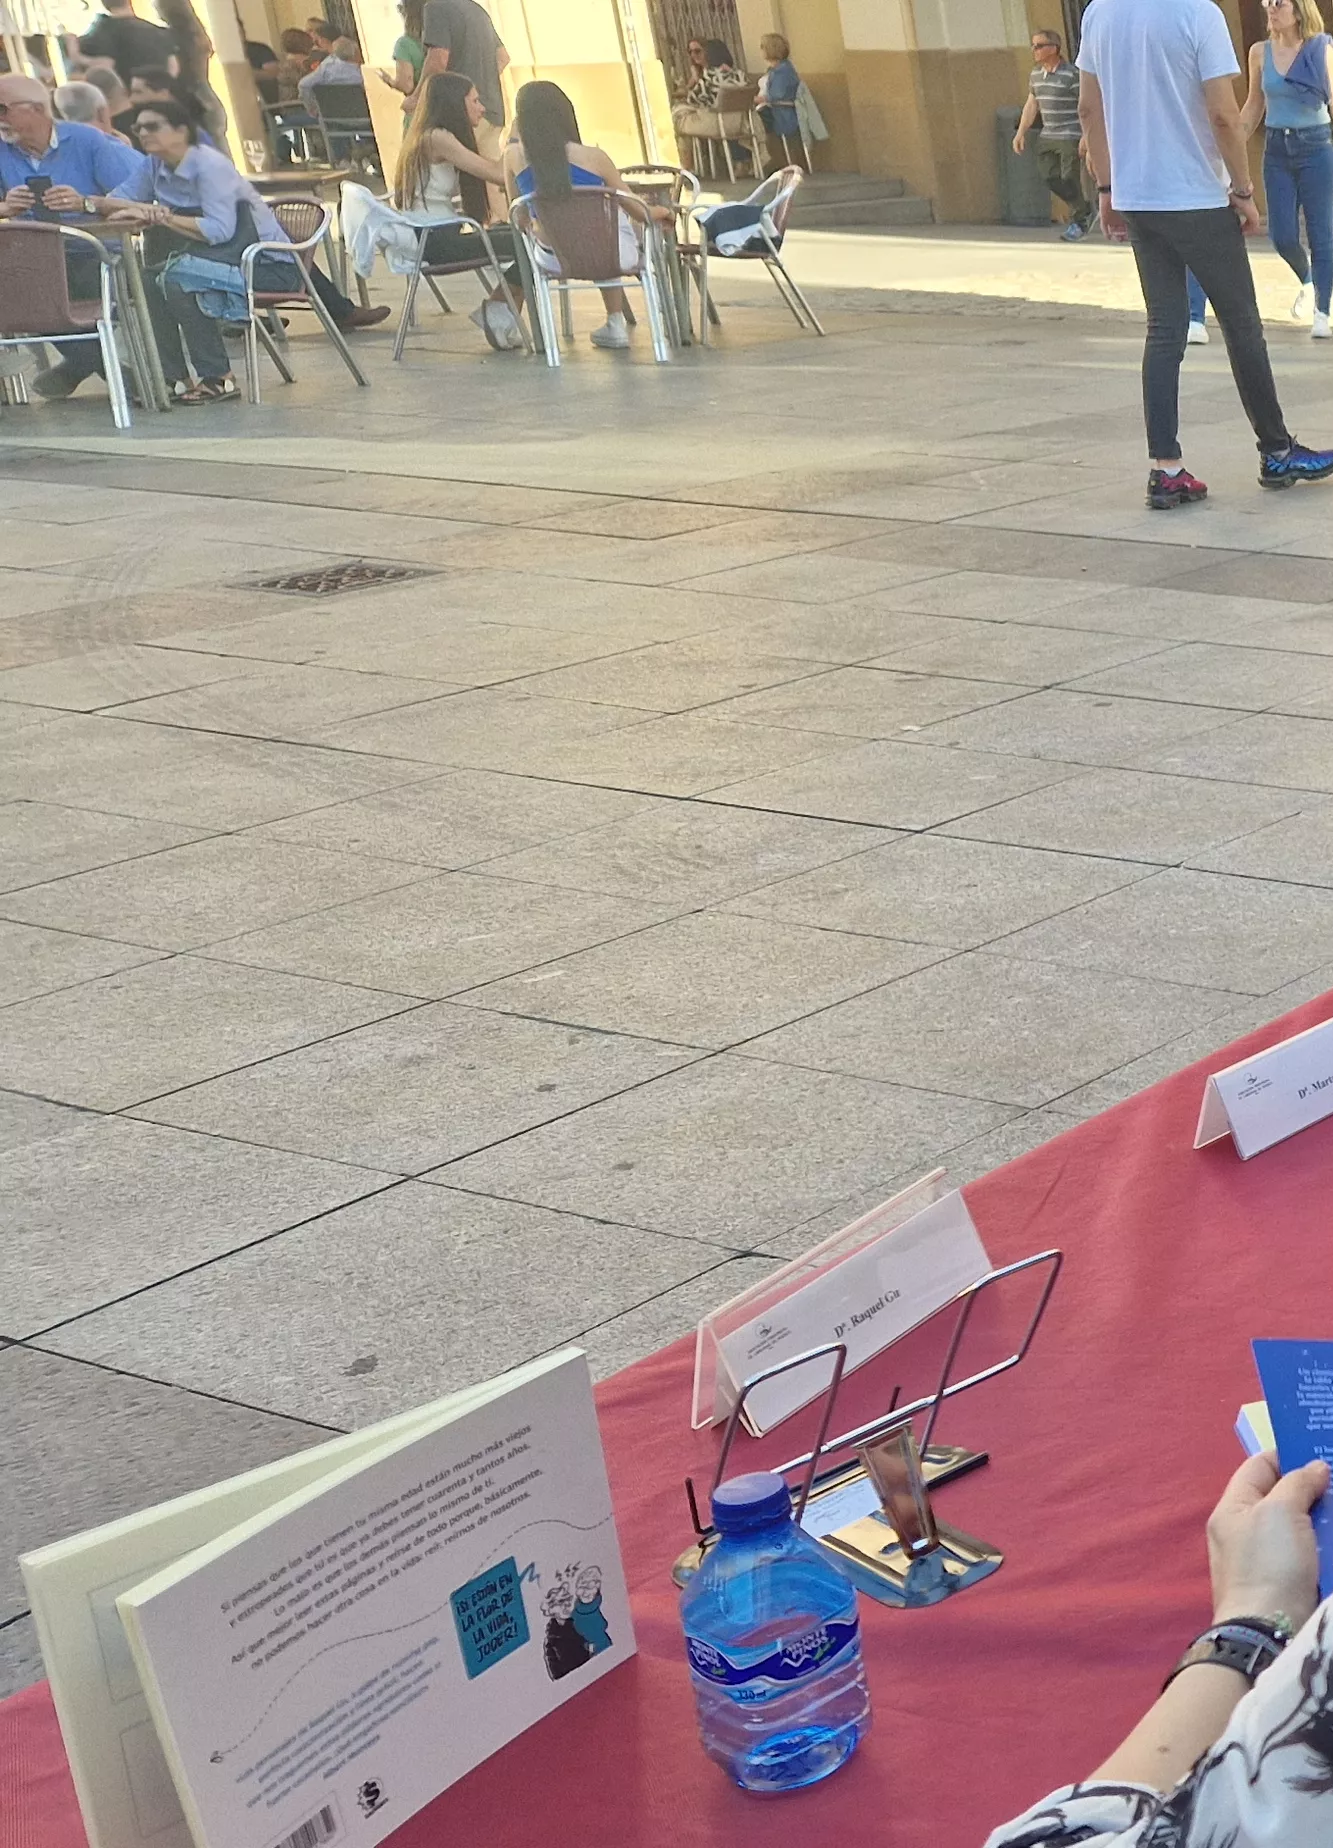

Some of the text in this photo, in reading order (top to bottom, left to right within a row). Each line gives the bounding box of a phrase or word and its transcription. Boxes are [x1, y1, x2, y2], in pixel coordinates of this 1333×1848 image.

[850, 1297, 884, 1327] Raquel
[884, 1290, 900, 1303] Gu
[248, 1638, 265, 1653] que
[413, 1535, 425, 1546] de
[427, 1522, 447, 1537] todo
[449, 1502, 483, 1527] porque,
[484, 1468, 544, 1505] básicamente,
[269, 1566, 287, 1582] que
[288, 1557, 303, 1569] los
[305, 1544, 323, 1559] que
[368, 1499, 399, 1520] misma
[401, 1482, 423, 1501] edad
[425, 1469, 451, 1488] están
[452, 1451, 483, 1473] mucho
[484, 1440, 504, 1454] más
[505, 1425, 532, 1443] viejos
[273, 1605, 286, 1617] Lo
[325, 1569, 342, 1583] que
[343, 1559, 358, 1571] los
[428, 1510, 439, 1520] lo
[439, 1492, 470, 1513] mismo
[471, 1484, 483, 1496] de
[296, 1569, 312, 1583] que
[339, 1541, 357, 1556] que
[372, 1516, 399, 1536] debes
[401, 1500, 425, 1518] tener
[427, 1478, 467, 1504] cuarenta
[476, 1456, 505, 1476] tantos
[507, 1442, 531, 1460] años.
[251, 1658, 263, 1669] no
[307, 1610, 333, 1630] hacer
[477, 1514, 489, 1526] de
[490, 1491, 531, 1518] nosotros.
[461, 1588, 514, 1632] LA FLOR DE
[472, 1628, 485, 1645] LA
[499, 1573, 513, 1590] EN
